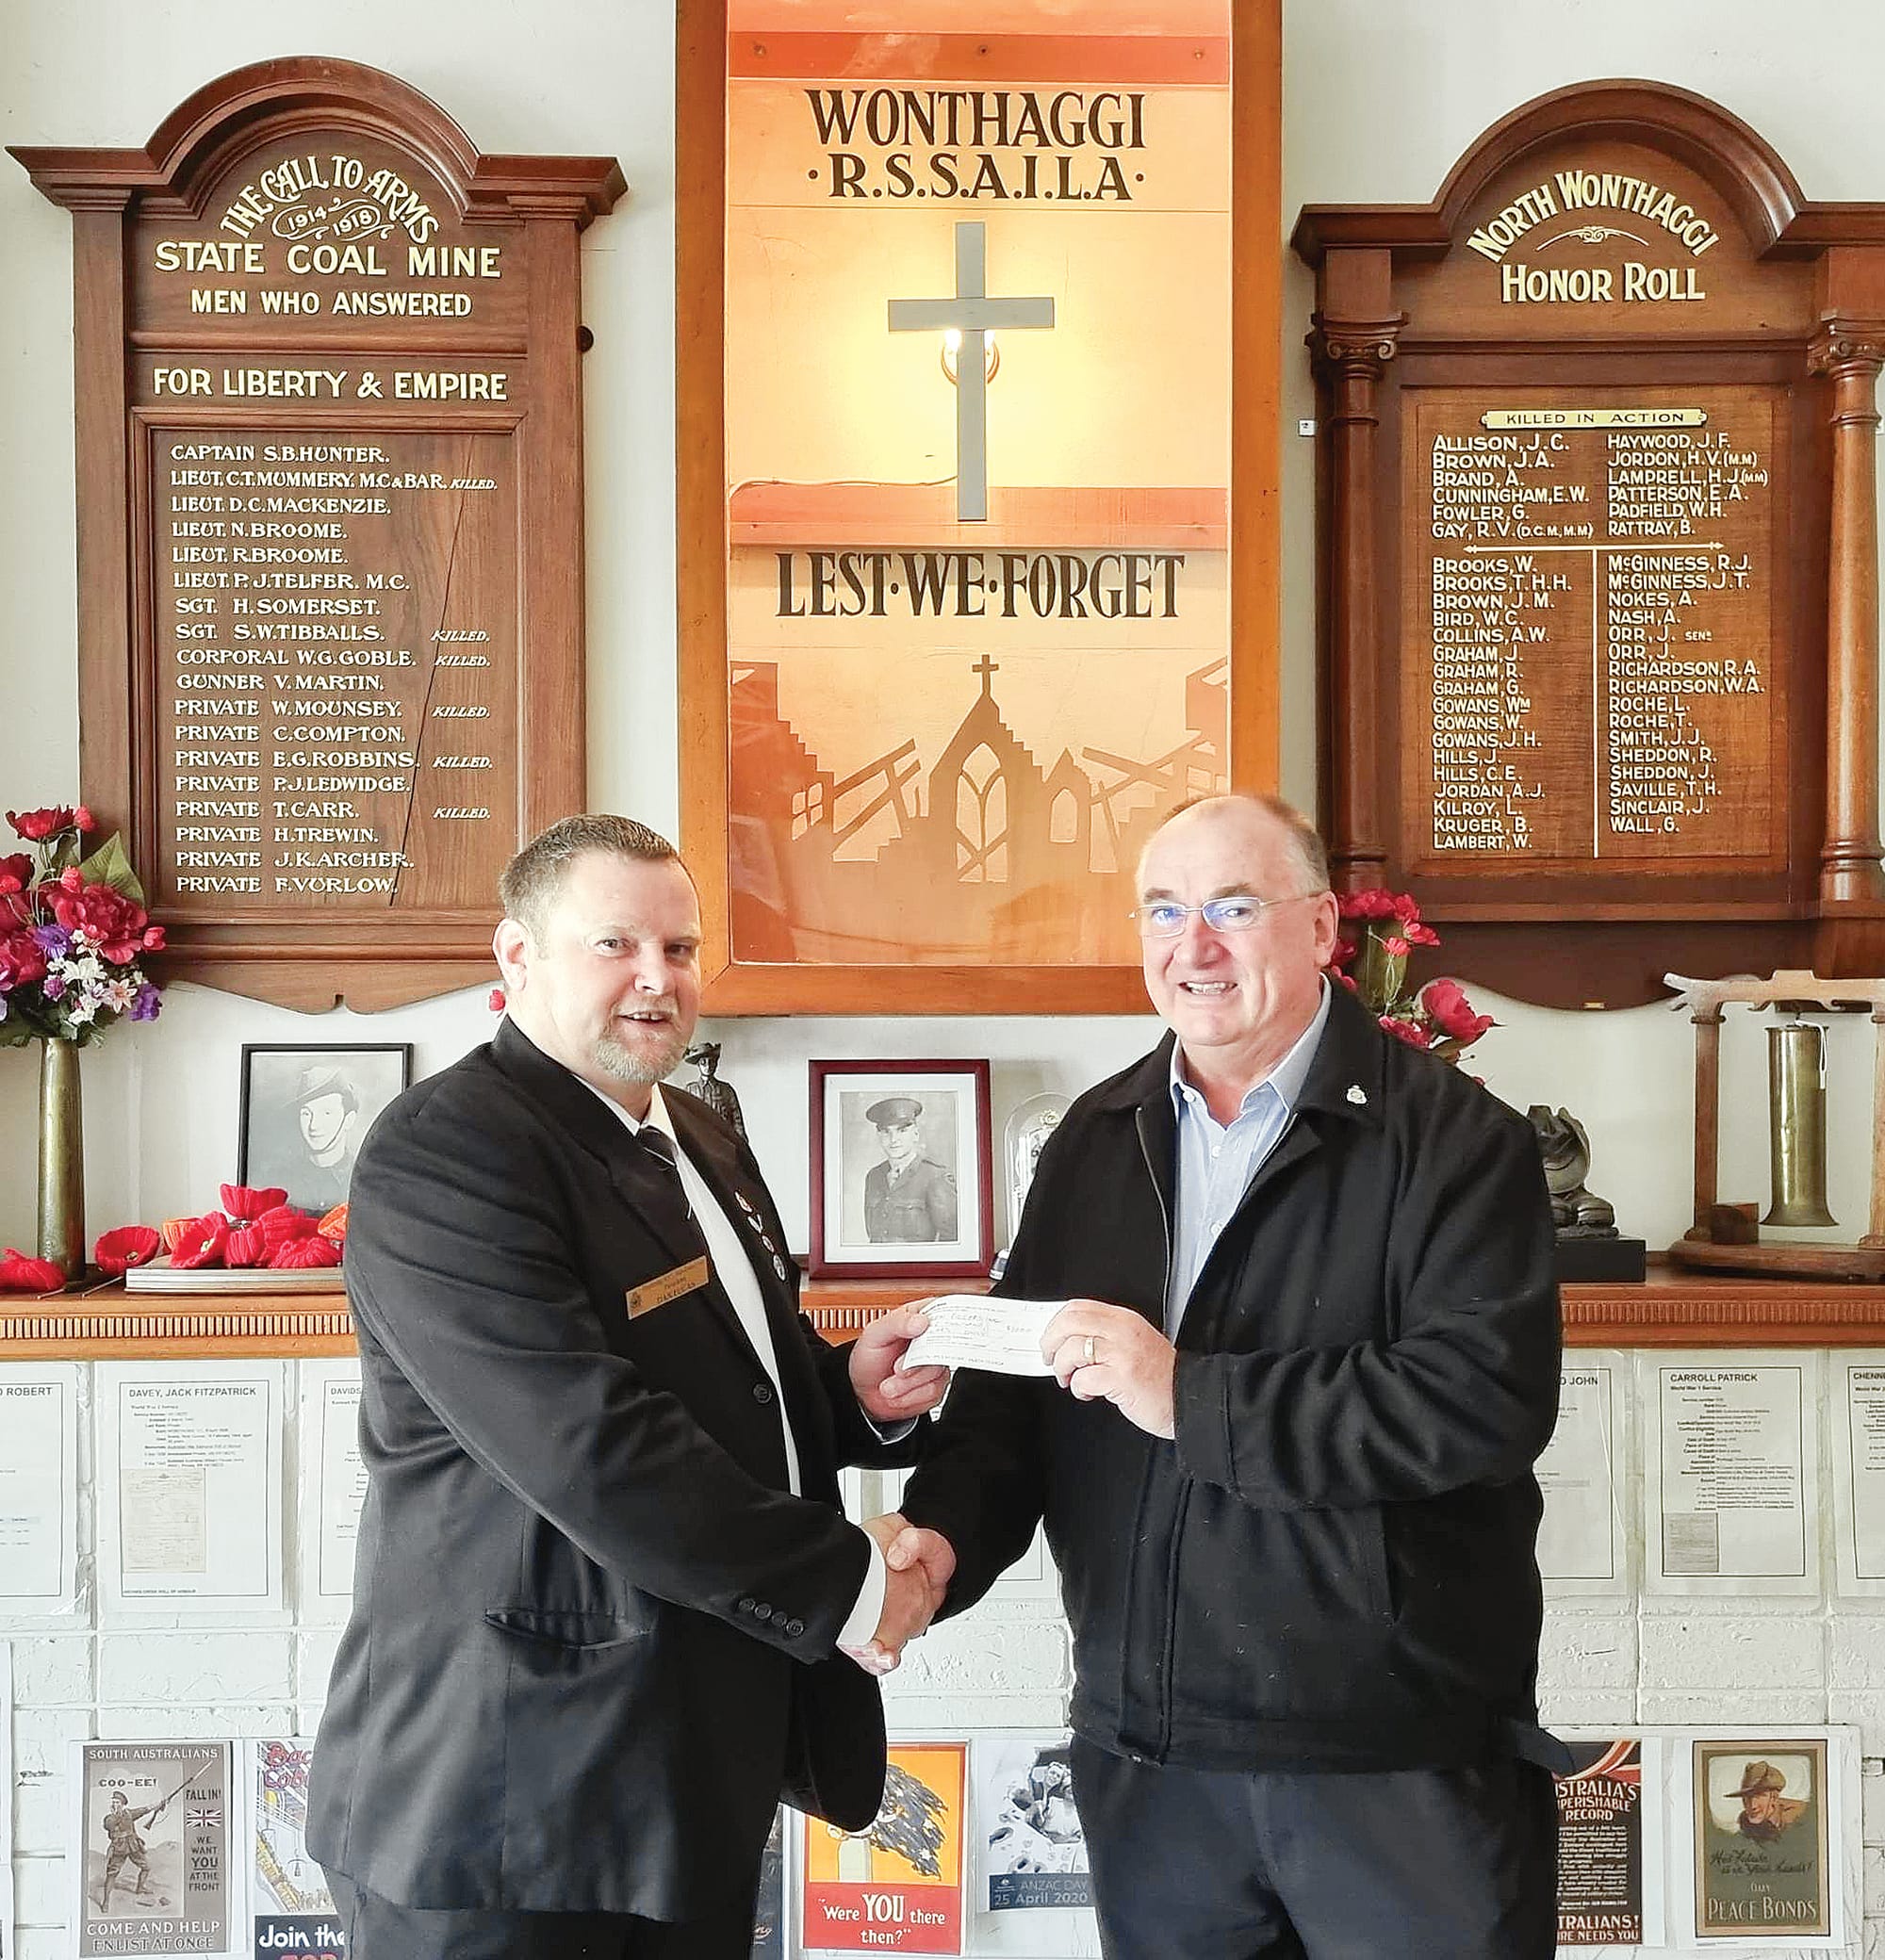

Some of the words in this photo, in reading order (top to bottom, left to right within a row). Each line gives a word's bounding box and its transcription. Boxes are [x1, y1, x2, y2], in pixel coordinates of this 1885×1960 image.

[804, 89, 1145, 148] WONTHAGGI
[220, 185, 274, 238] THE
[260, 155, 329, 203] CALL
[332, 155, 364, 188] TO
[362, 170, 439, 244] ARMS
[333, 209, 372, 236] 1918
[1466, 184, 1558, 264] NORTH
[1555, 170, 1720, 257] WONTHAGGI
[155, 241, 265, 273] STATE
[287, 244, 387, 276] COAL
[408, 247, 501, 278] MINE
[1501, 263, 1614, 304] HONOR
[1624, 262, 1706, 302] ROLL
[191, 290, 247, 314] MEN
[260, 291, 320, 316] WHO
[332, 292, 471, 317] ANSWERED
[153, 368, 213, 396] FOR
[223, 369, 349, 398] LIBERTY
[357, 372, 385, 399] &
[394, 372, 508, 400] EMPIRE
[1506, 414, 1565, 425] KILLED
[1577, 414, 1595, 424] IN
[1610, 413, 1685, 424] ACTION
[171, 445, 254, 462] CAPTAIN
[171, 469, 223, 488] LIEUT.
[450, 478, 498, 490] KILLED.
[171, 496, 225, 514] LIEUT.
[172, 521, 226, 538] LIEUT.
[172, 547, 227, 564] LIEUT.
[173, 572, 230, 590] LIEUT.
[366, 573, 410, 591] M.C.
[175, 597, 219, 614] SGT.
[175, 623, 218, 640] SGT.
[430, 629, 490, 643] KILLED.
[175, 648, 289, 666] CORPORAL
[433, 655, 491, 667] KILLED.
[176, 674, 265, 691] GUNNER
[174, 699, 260, 716] PRIVATE
[432, 706, 490, 718] KILLED.
[175, 725, 260, 742] PRIVATE
[175, 750, 260, 768] PRIVATE
[432, 757, 494, 769] KILLED.
[175, 776, 260, 792] PRIVATE
[175, 801, 261, 818] PRIVATE
[433, 807, 491, 819] KILLED.
[175, 826, 262, 843] PRIVATE
[175, 851, 262, 869] PRIVATE
[176, 876, 262, 894] PRIVATE
[1569, 1376, 1598, 1386] JOHN
[1670, 1373, 1716, 1382] CARROLL
[1717, 1373, 1758, 1382] PATRICK
[7, 1386, 53, 1396] ROBERT
[128, 1389, 163, 1398] DAVEY,
[165, 1388, 192, 1397] JACK
[194, 1387, 256, 1396] FITZPATRICK
[330, 1387, 362, 1396] DAVIDS
[90, 1749, 128, 1759] SOUTH
[133, 1748, 219, 1759] AUSTRALIANS
[186, 1789, 205, 1801] FALL
[1565, 1808, 1615, 1822] RECORD
[191, 1846, 218, 1854] WANT
[191, 1856, 218, 1868] YOU
[188, 1883, 219, 1891] FRONT
[994, 1894, 1011, 1906] 25
[1015, 1891, 1049, 1905] April
[1054, 1890, 1088, 1904] 2020
[861, 1893, 905, 1923] YOU
[910, 1908, 946, 1924] there
[1762, 1896, 1817, 1920] BONDS
[87, 1922, 133, 1936] COME
[139, 1921, 174, 1934] AND
[179, 1920, 220, 1932] HELP
[1557, 1915, 1640, 1930] TRALIANS!
[93, 1938, 148, 1952] ENLIST
[152, 1938, 172, 1951] AT
[175, 1936, 214, 1950] ONCE
[258, 1923, 311, 1948] Join
[1578, 1930, 1615, 1941] NEEDS
[1617, 1930, 1639, 1941] YOU
